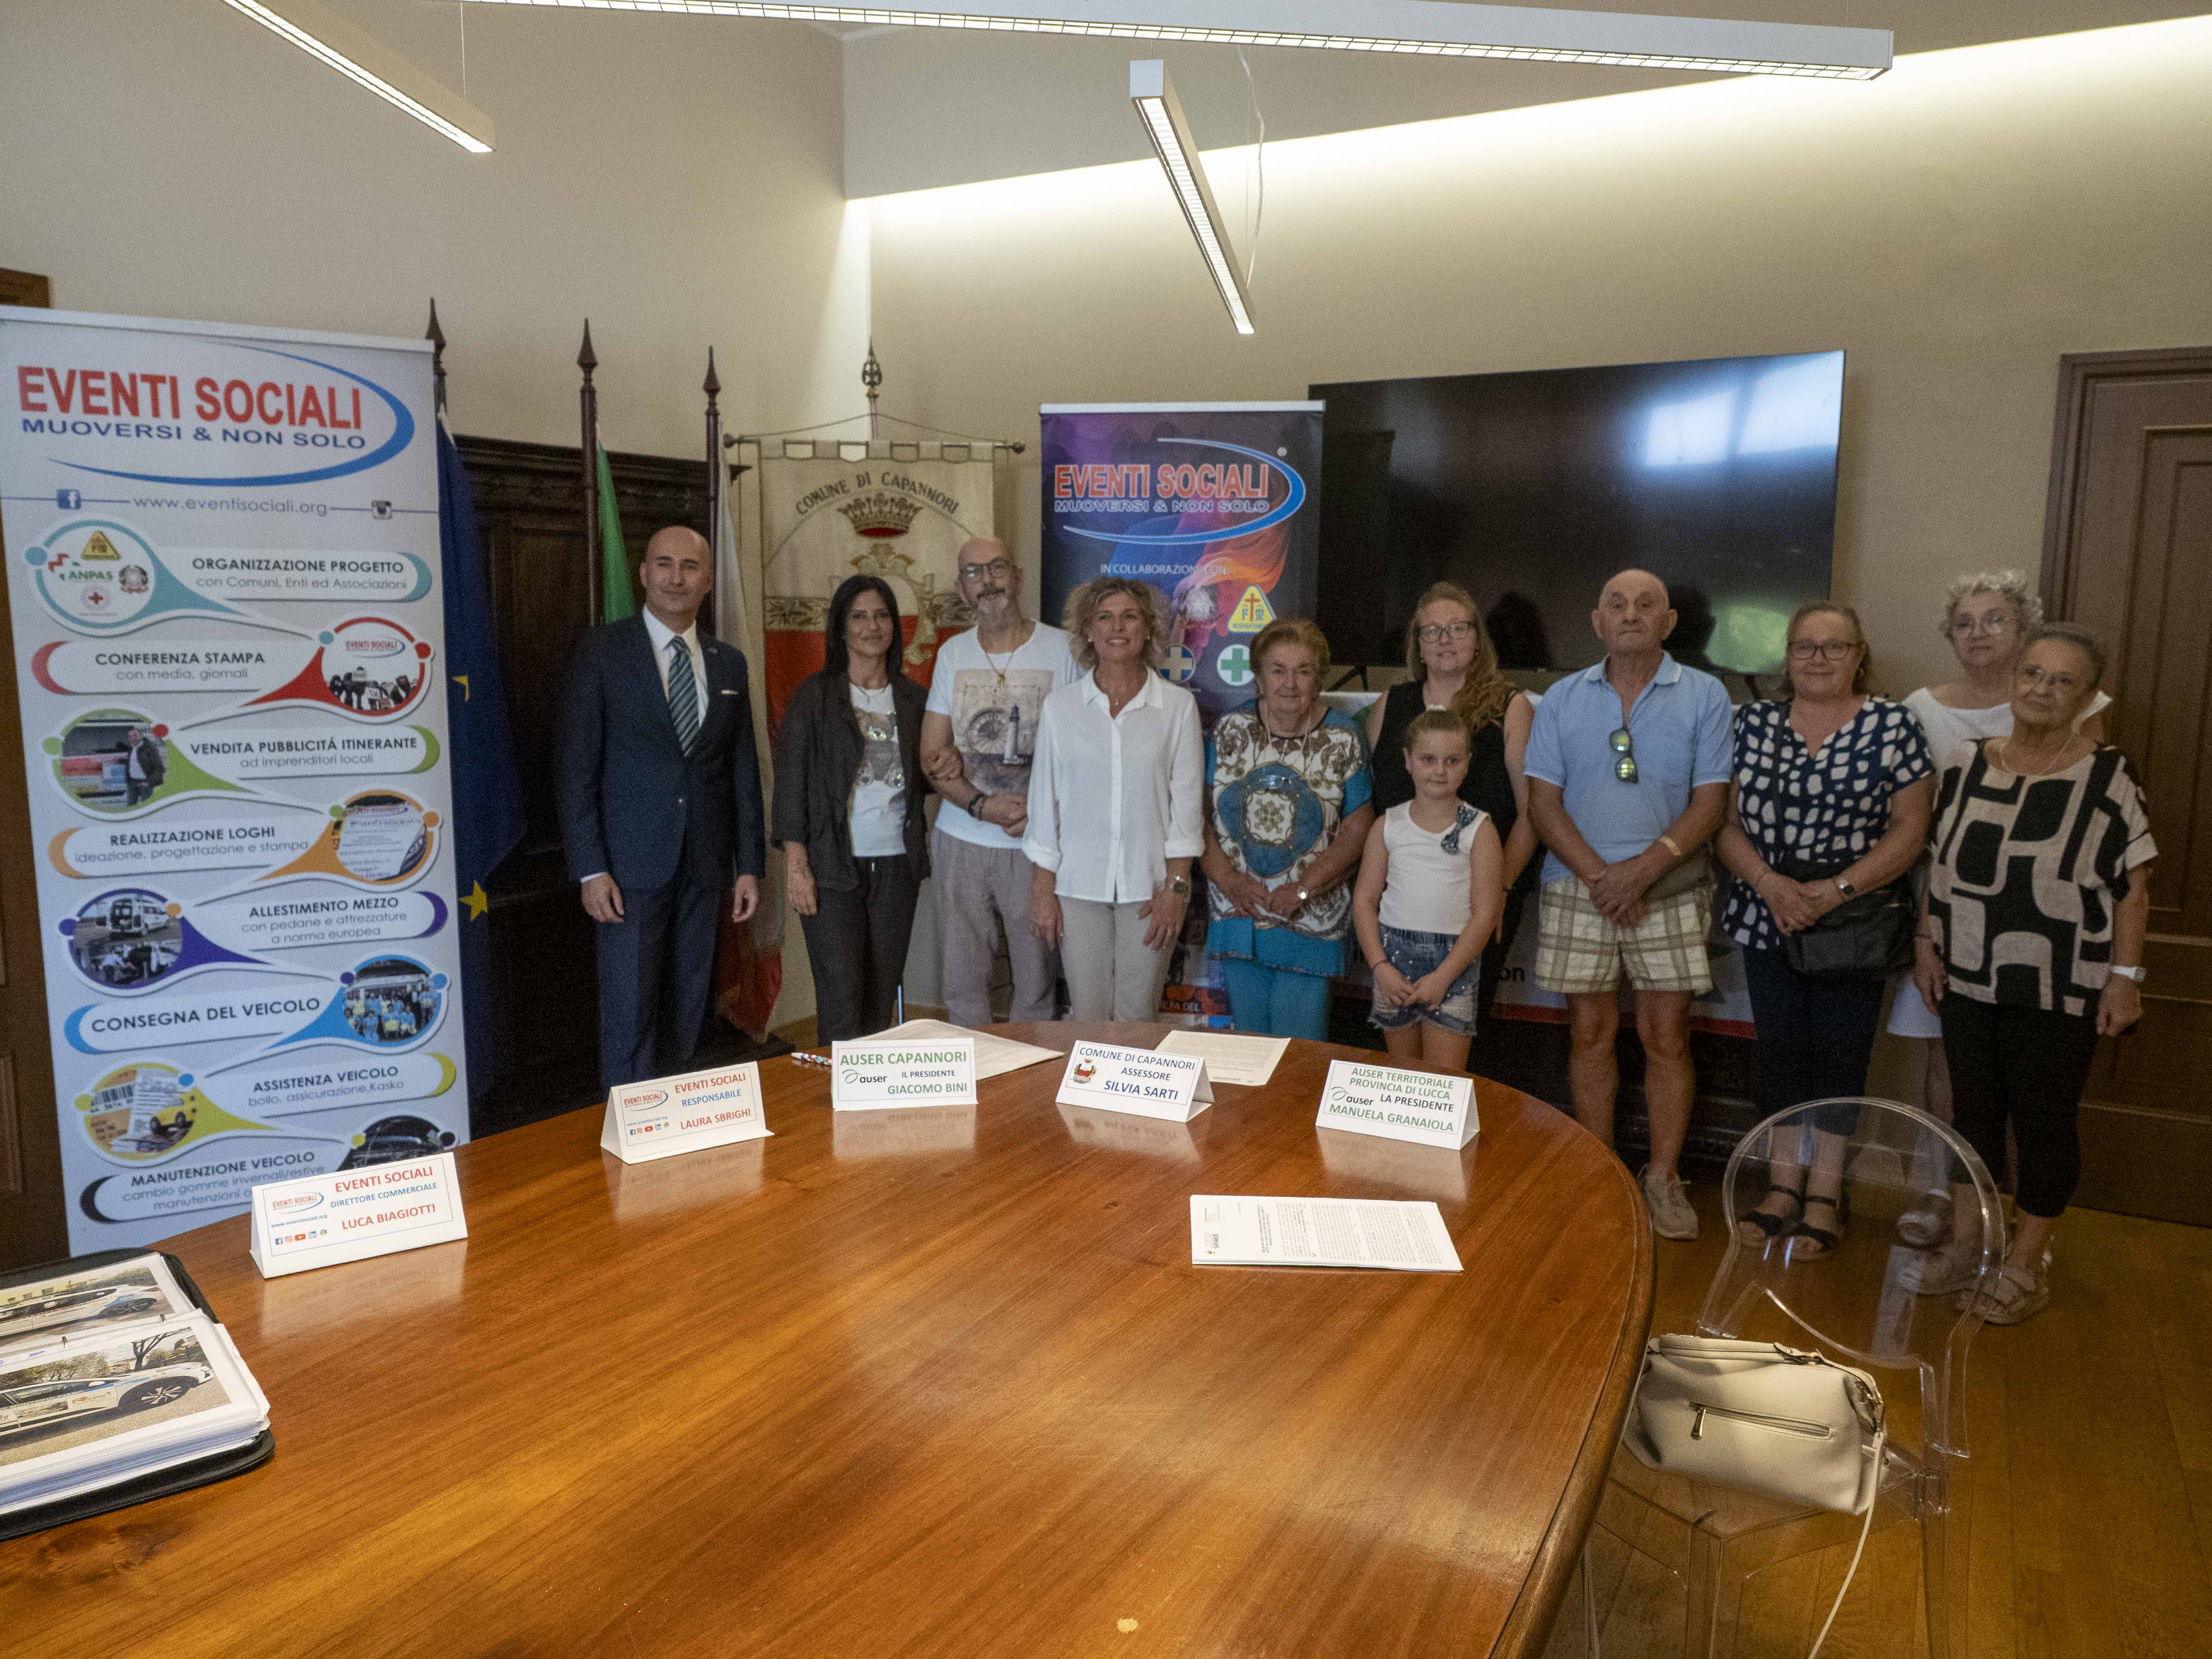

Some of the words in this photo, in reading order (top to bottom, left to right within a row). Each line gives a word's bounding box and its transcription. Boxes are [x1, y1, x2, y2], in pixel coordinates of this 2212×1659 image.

[17, 366, 180, 419] EVENTI
[195, 377, 361, 429] SOCIALI
[22, 419, 182, 440] MUOVERSI
[194, 427, 212, 442] &
[222, 429, 282, 445] NON
[294, 433, 366, 450] SOLO
[1054, 464, 1150, 498] EVENTI
[1157, 463, 1269, 498] SOCIALI
[795, 480, 850, 515] COMUNE
[856, 471, 871, 488] DI
[881, 471, 959, 514] CAPANNORI
[133, 495, 326, 516] www.eventisociali.org
[1054, 500, 1149, 512] MUOVERSI
[1153, 500, 1168, 512] &
[1172, 501, 1214, 512] NON
[1218, 500, 1269, 513] SOLO
[192, 559, 326, 571] ORGANIZZAZIONE
[331, 561, 403, 573] PROGETTO
[1100, 564, 1111, 574] IN
[1113, 564, 1202, 574] COLLABORAZIONE
[196, 578, 222, 588] con
[285, 578, 307, 588] Enti
[311, 578, 329, 588] ed
[333, 579, 406, 589] Associazioni
[96, 653, 199, 665] CONFERENZA
[205, 652, 265, 664] STAMPA
[116, 670, 143, 680] con
[199, 668, 247, 680] giornali
[190, 742, 253, 754] VENDITA
[342, 737, 417, 750] ITINERANTE
[240, 758, 258, 768] ad
[262, 756, 336, 768] imprenditori
[340, 754, 373, 765] locali
[111, 829, 223, 846] REALIZZAZIONE
[229, 827, 275, 838] LOGHI
[150, 844, 244, 860] progettazione
[260, 841, 308, 854] stampa
[250, 901, 348, 918] ALLESTIMENTO
[353, 897, 399, 910] MEZZO
[242, 923, 266, 933] con
[271, 918, 321, 930] pedane
[337, 911, 407, 924] attrezzature
[271, 935, 280, 944] a
[284, 932, 325, 943] norma
[329, 927, 380, 940] europea
[92, 1011, 200, 1032] CONSEGNA
[207, 1007, 236, 1020] DEL
[242, 998, 320, 1017] VEICOLO
[840, 1055, 884, 1065] AUSER
[888, 1052, 966, 1063] CAPANNORI
[1080, 1048, 1123, 1060] COMUNE
[1125, 1054, 1135, 1062] DI
[1138, 1055, 1195, 1070] CAPANNORI
[253, 1074, 332, 1092] ASSISTENZA
[337, 1066, 398, 1082] VEICOLO
[675, 1080, 708, 1093] EVENTI
[711, 1073, 745, 1086] SOCIALI
[1121, 1068, 1171, 1081] ASSESSORE
[1352, 1068, 1383, 1079] AUSER
[1386, 1073, 1454, 1089] TERRITORIALE
[624, 1097, 641, 1105] EVENTI
[643, 1092, 662, 1101] SOCIALI
[682, 1089, 741, 1106] RESPONSABILE
[888, 1084, 942, 1094] GIACOMO
[946, 1083, 967, 1092] BINI
[1104, 1080, 1139, 1094] SILVIA
[1144, 1086, 1178, 1100] SARTI
[1350, 1078, 1402, 1093] PROVINCIA
[1406, 1085, 1416, 1094] DI
[1419, 1086, 1449, 1099] LUCCA
[1347, 1095, 1374, 1106] auser
[1381, 1094, 1391, 1103] LA
[1395, 1096, 1454, 1112] PRESIDENTE
[681, 1116, 712, 1130] LAURA
[715, 1109, 751, 1123] SBRIGHI
[1329, 1104, 1383, 1121] MANUELA
[1388, 1113, 1453, 1132] GRANAIOLA
[131, 1160, 246, 1187] MANUTENZIONE
[251, 1152, 314, 1169] VEICOLO
[335, 1176, 381, 1193] EVENTI
[384, 1166, 433, 1184] SOCIALI
[123, 1187, 173, 1202] cambio
[178, 1179, 227, 1193] gomme
[154, 1189, 239, 1210] manutenzioni
[330, 1193, 376, 1208] DIRETTORE
[378, 1182, 437, 1199] COMMERCIALE
[273, 1199, 293, 1208] EVENTI
[294, 1195, 317, 1203] SOCIALI
[271, 1215, 327, 1228] www.eventisociali.org
[342, 1216, 373, 1230] LUCA
[377, 1204, 436, 1222] BIAGIOTTI
